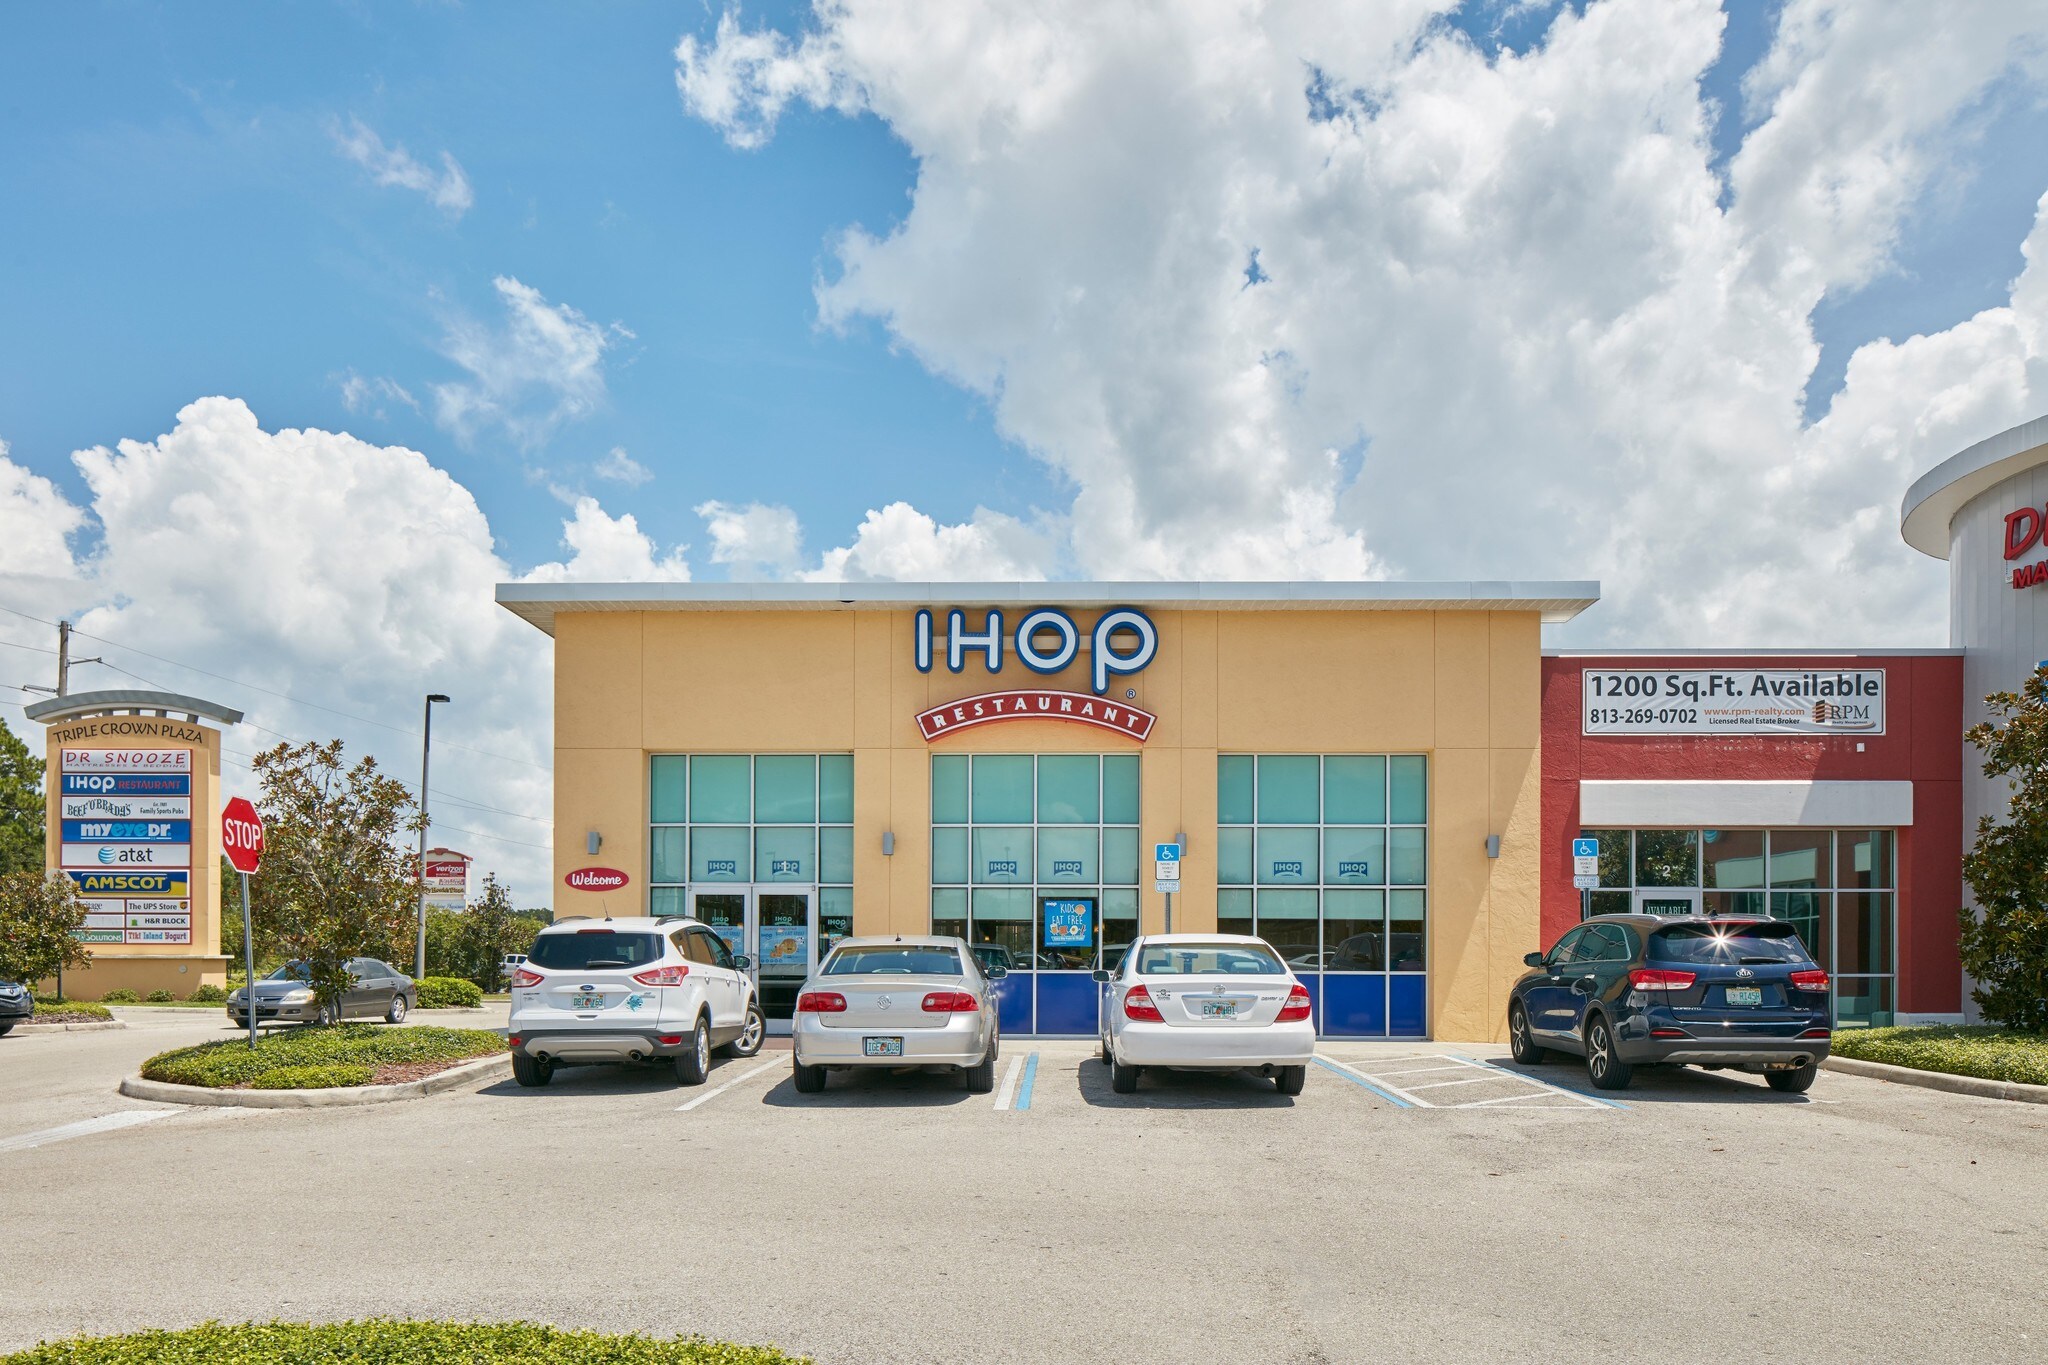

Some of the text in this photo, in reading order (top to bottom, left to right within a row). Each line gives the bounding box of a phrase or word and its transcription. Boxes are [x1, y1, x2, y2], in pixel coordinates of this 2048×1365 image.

[2004, 502, 2048, 560] D
[915, 608, 1158, 695] IHOP
[1591, 674, 1879, 702] 1200 Sq.Ft. Available
[932, 697, 1139, 729] RESTAURANT
[1590, 708, 1697, 724] 813-269-0702
[1704, 706, 1805, 716] www.rpm-realty.com
[1830, 705, 1870, 719] RPM
[1709, 717, 1800, 725] Licensed Real Estate Broker
[53, 722, 203, 744] TRIPLE CROWN PLAZA
[66, 752, 186, 764] DR SNOOZE
[70, 776, 181, 793] IHOP RESTAURANT
[225, 818, 261, 851] STOP
[119, 847, 153, 863] at&t
[436, 865, 464, 873] verizon
[709, 862, 735, 873] IHOP
[990, 863, 1016, 873] IHOP
[1055, 863, 1081, 873] IHOP
[1275, 863, 1301, 873] IHOP
[1341, 863, 1367, 873] IHOP
[1662, 865, 1671, 877] 2
[85, 876, 166, 889] AMSCOT
[571, 871, 623, 886] Welcome
[1060, 903, 1075, 914] KIDS
[1646, 906, 1687, 914] AVAILABLE
[1051, 915, 1083, 925] EAT FREE
[86, 934, 122, 942] SOLUTIONS
[164, 932, 187, 941] Yogurt
[1739, 969, 1752, 977] KIA
